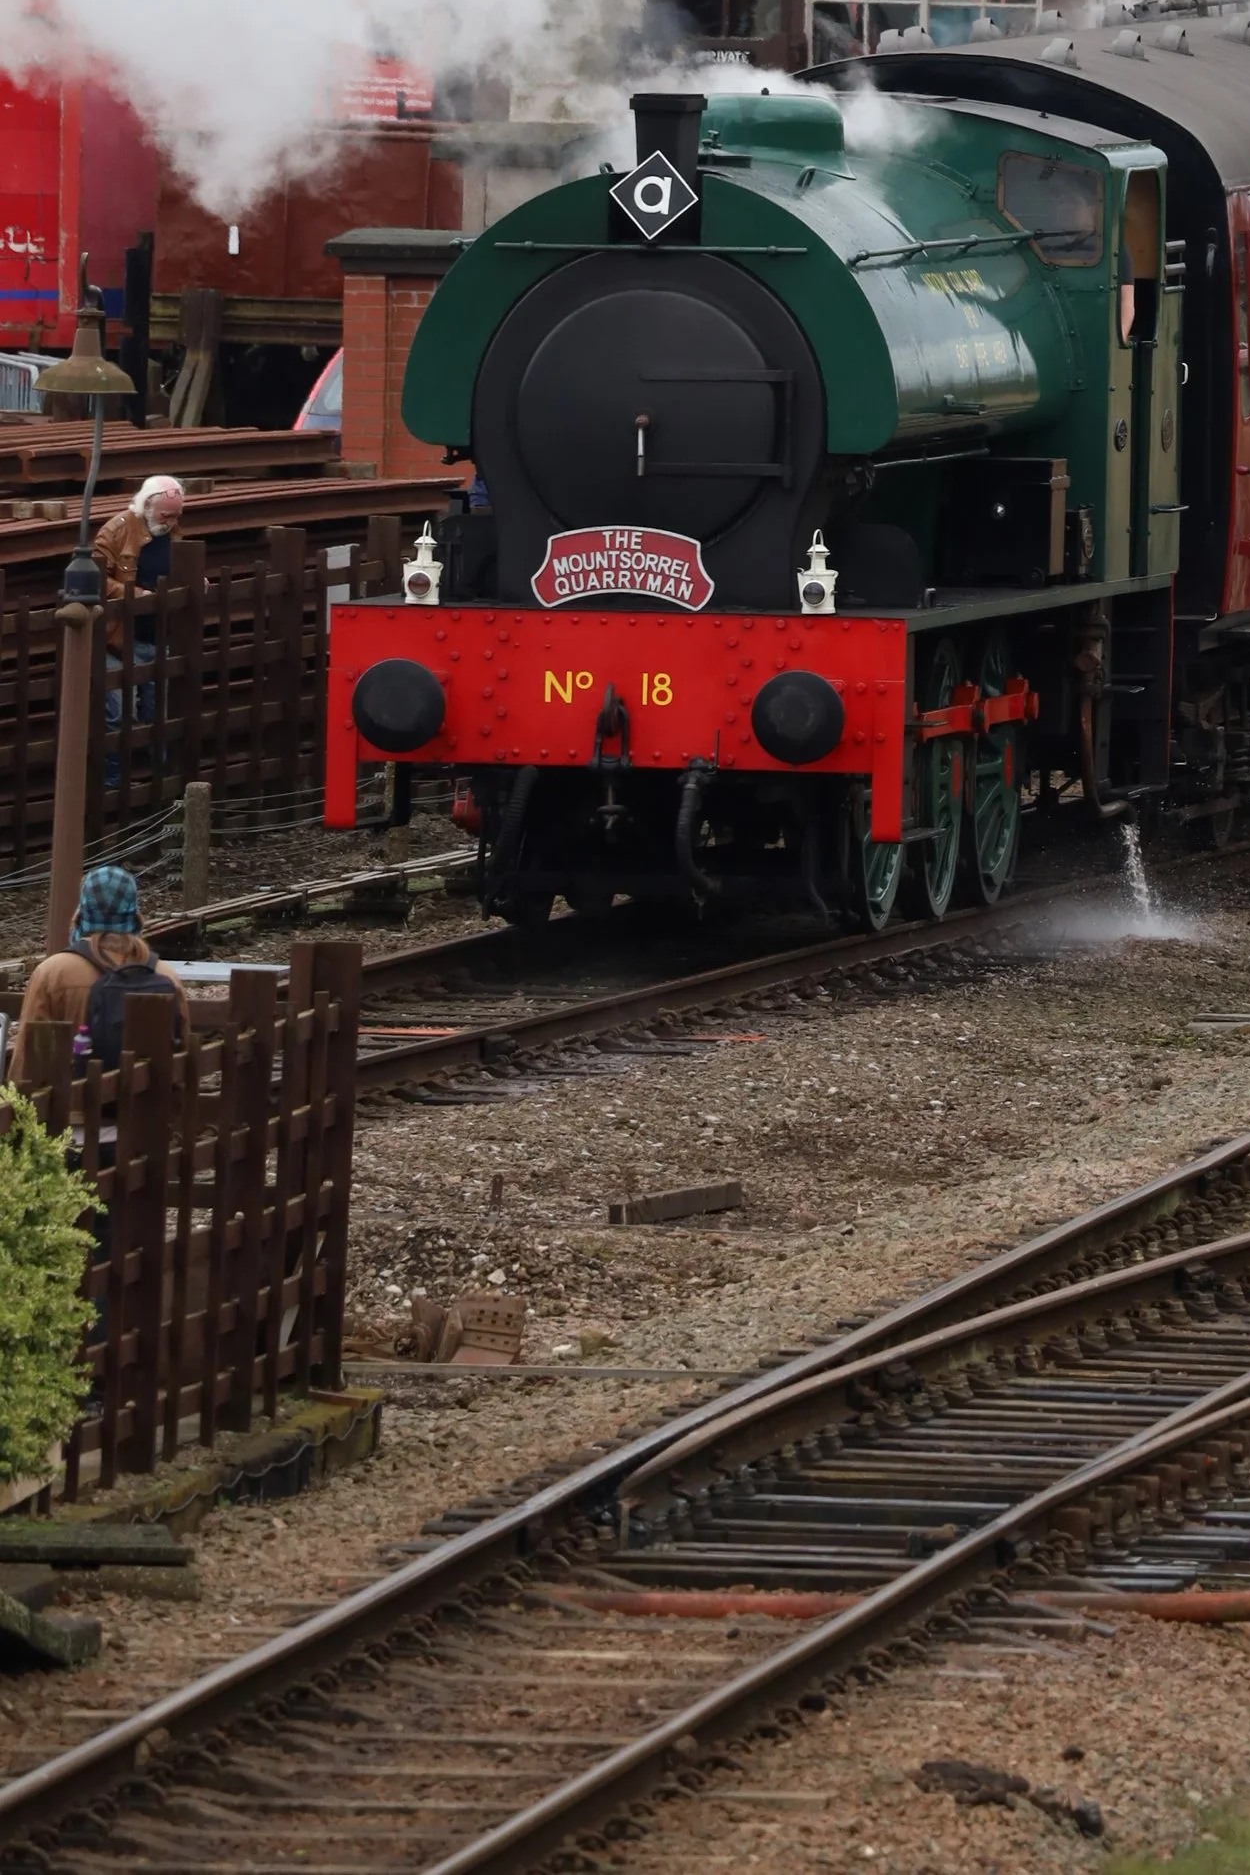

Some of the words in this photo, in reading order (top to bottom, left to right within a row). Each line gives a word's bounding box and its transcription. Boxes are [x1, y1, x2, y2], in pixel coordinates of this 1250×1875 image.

[602, 530, 644, 550] THE
[552, 550, 693, 582] MOUNTSORREL
[554, 570, 694, 601] QUARRYMAN
[641, 672, 674, 706] 18
